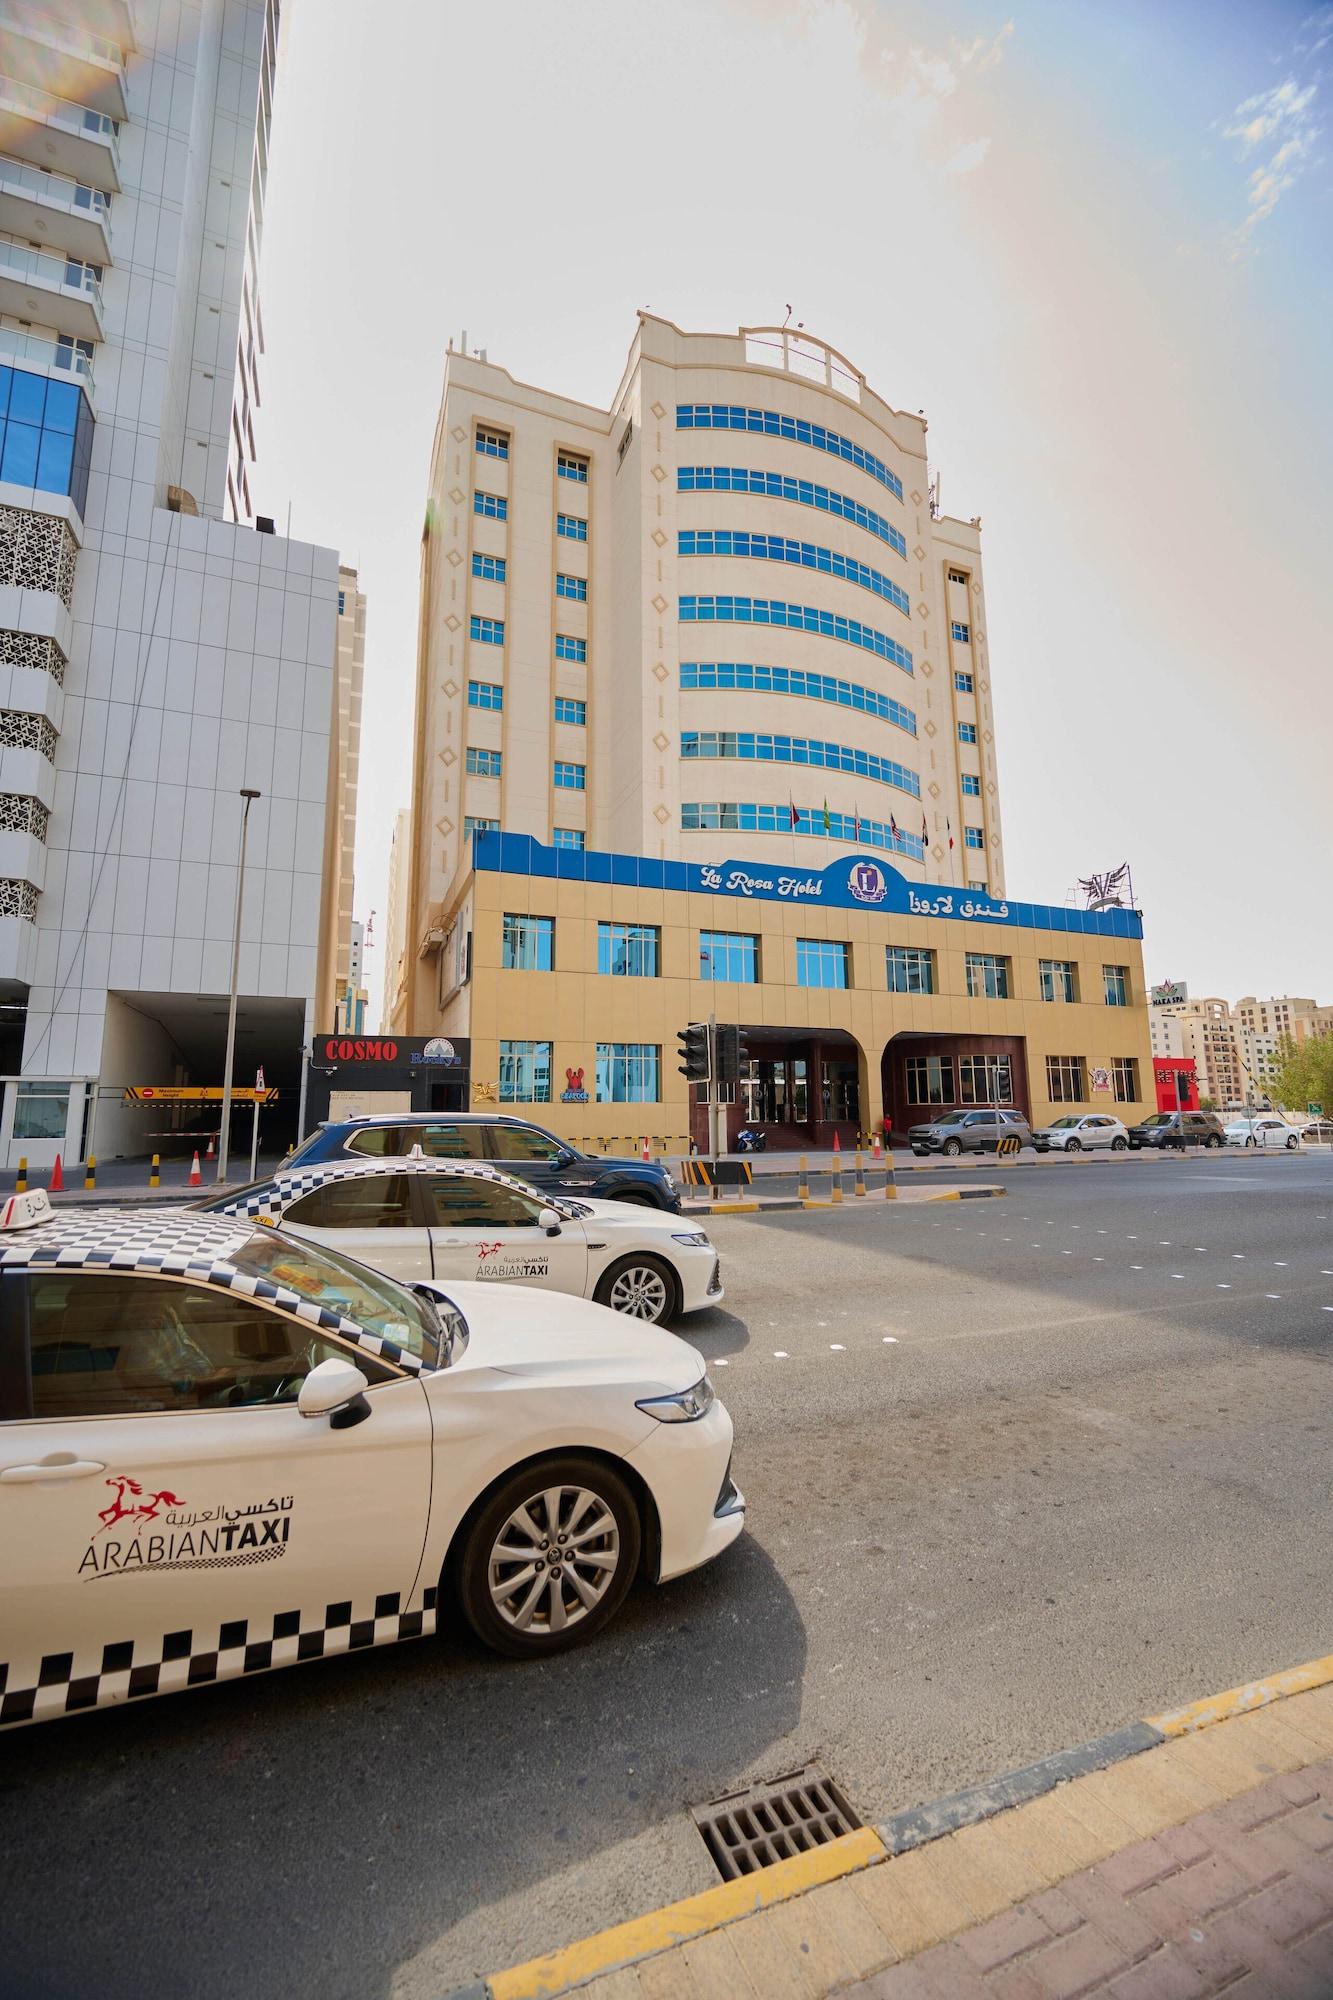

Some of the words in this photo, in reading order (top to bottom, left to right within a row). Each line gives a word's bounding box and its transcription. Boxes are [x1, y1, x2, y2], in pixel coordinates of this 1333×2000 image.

[700, 866, 722, 889] La
[726, 871, 774, 896] Rosa
[778, 876, 823, 897] Hotel
[959, 900, 1009, 918] فندق
[325, 1039, 398, 1061] COSMO
